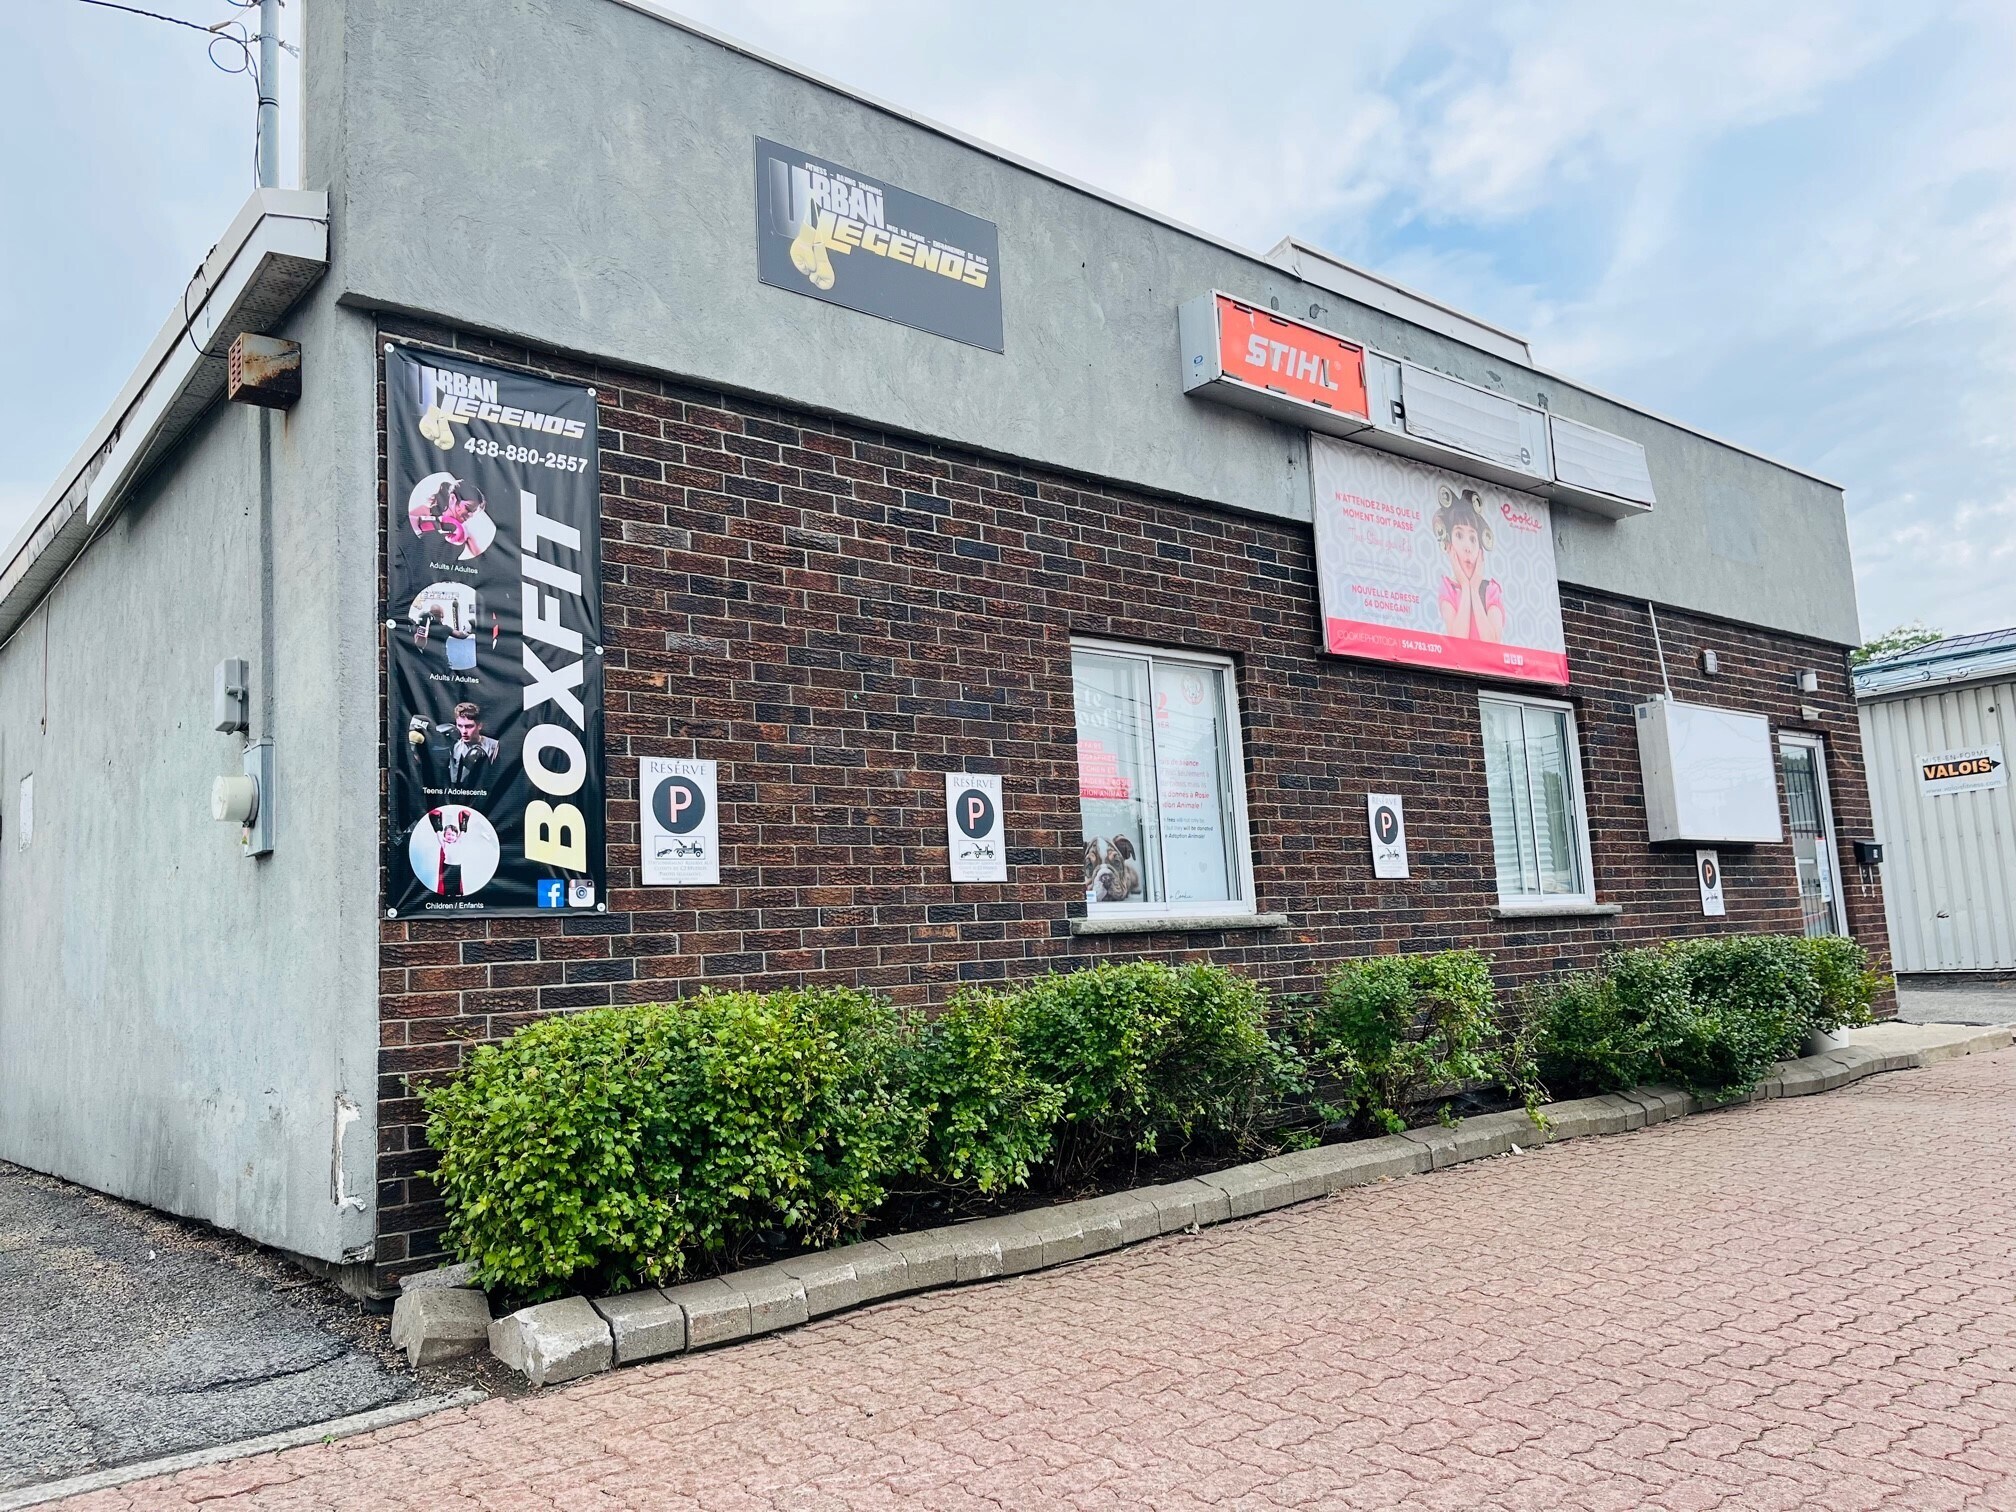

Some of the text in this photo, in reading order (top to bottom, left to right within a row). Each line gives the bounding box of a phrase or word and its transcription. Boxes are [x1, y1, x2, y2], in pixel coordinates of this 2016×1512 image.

[769, 157, 885, 239] URBAN
[816, 208, 989, 289] LEGENDS
[1245, 333, 1339, 392] STIHL
[404, 360, 498, 417] URBAN
[441, 394, 587, 439] LEGENDS
[463, 437, 588, 474] 438-880-2557
[1335, 490, 1421, 520] N'ATTENDEZ PAS QUE LE
[1342, 507, 1375, 523] MOMENT
[1375, 515, 1392, 527] SOIT
[429, 560, 450, 571] Adults
[454, 564, 479, 575] Adultes
[1351, 584, 1420, 605] NOUVELLE ADRESSE
[1364, 598, 1373, 608] 64
[429, 673, 451, 682] Adults
[455, 676, 480, 684] Adultes
[520, 488, 587, 873] BOXFIT
[1923, 758, 1991, 779] VALOIS
[422, 786, 443, 795] Teens
[448, 787, 487, 796] Adolescents
[669, 785, 693, 823] P
[968, 797, 985, 830] P
[1381, 812, 1393, 838] P
[1705, 864, 1713, 884] P
[425, 901, 454, 910] Children
[458, 902, 484, 910] Enfants
